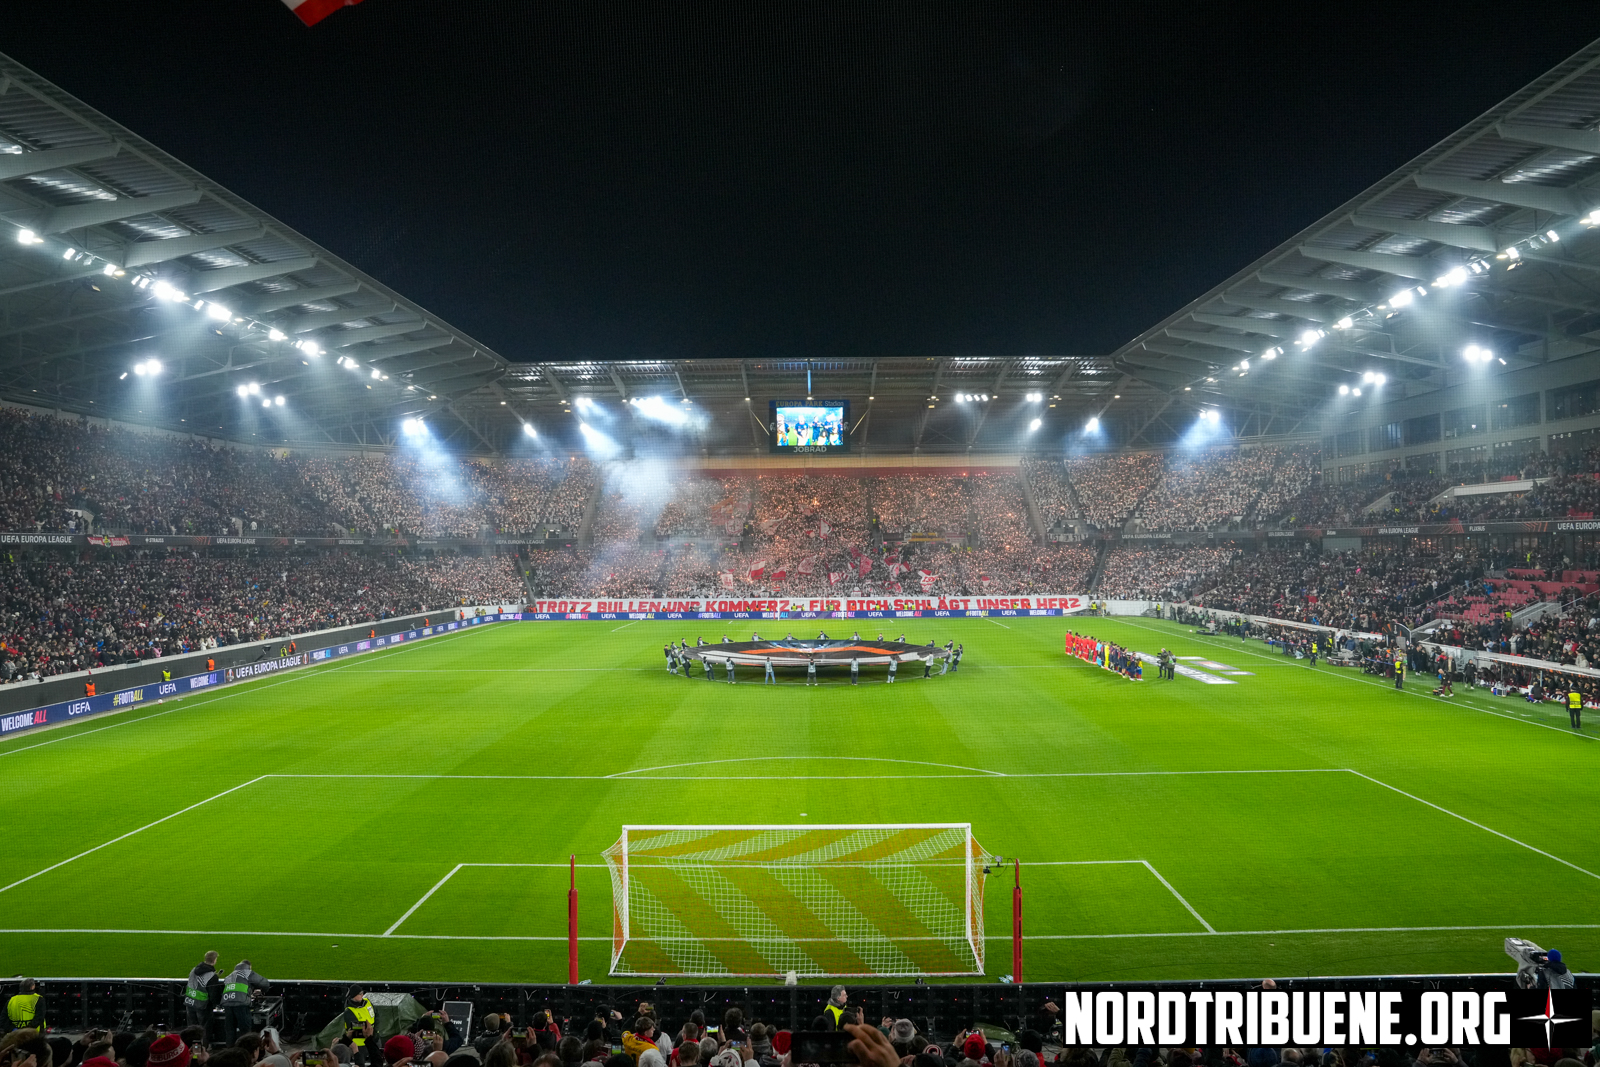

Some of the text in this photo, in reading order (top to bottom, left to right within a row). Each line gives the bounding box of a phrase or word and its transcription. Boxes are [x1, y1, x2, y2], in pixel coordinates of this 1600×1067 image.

[1557, 522, 1574, 530] UEFA
[1, 535, 72, 543] UEFA EUROPA LEAGUE
[536, 601, 592, 613] TROTZ
[597, 601, 662, 613] BULLEN
[705, 600, 790, 612] KOMMERZ
[847, 600, 888, 611] DICH
[894, 597, 970, 610] SCHLÄGT
[976, 599, 1031, 609] UNSER
[1036, 598, 1081, 609] HERZ
[339, 646, 349, 654] UEFA
[236, 655, 302, 678] UEFA EUROPA LEAGUE
[190, 673, 217, 689] WELCOME ALL
[159, 683, 177, 695] UEFA
[113, 689, 143, 706] #FOOTBALL
[68, 701, 91, 715] UEFA
[1, 709, 47, 732] WELCOME ALL
